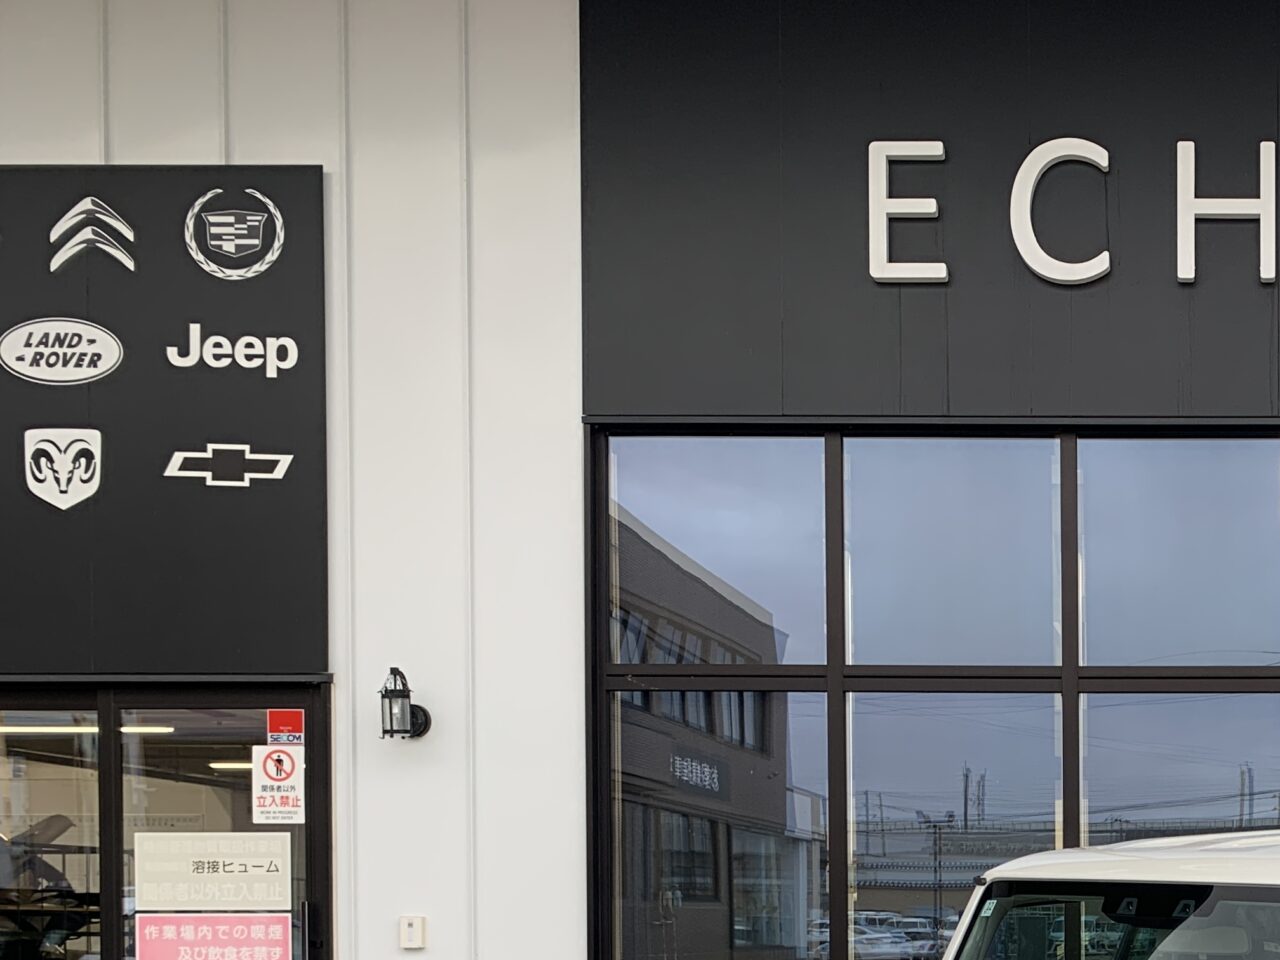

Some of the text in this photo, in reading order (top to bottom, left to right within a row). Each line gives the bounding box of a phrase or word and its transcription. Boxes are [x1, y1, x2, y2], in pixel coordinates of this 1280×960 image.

[23, 331, 83, 348] LAND
[166, 323, 299, 378] Jeep
[28, 351, 103, 368] ROVER
[270, 734, 302, 744] SECOM
[261, 784, 296, 793] 関係者以外
[256, 795, 301, 808] 立入禁止
[192, 860, 280, 874] 溶接ヒューム
[144, 924, 284, 940] 作業場内での喫煙
[178, 946, 283, 960] 及び飲食を禁ず
